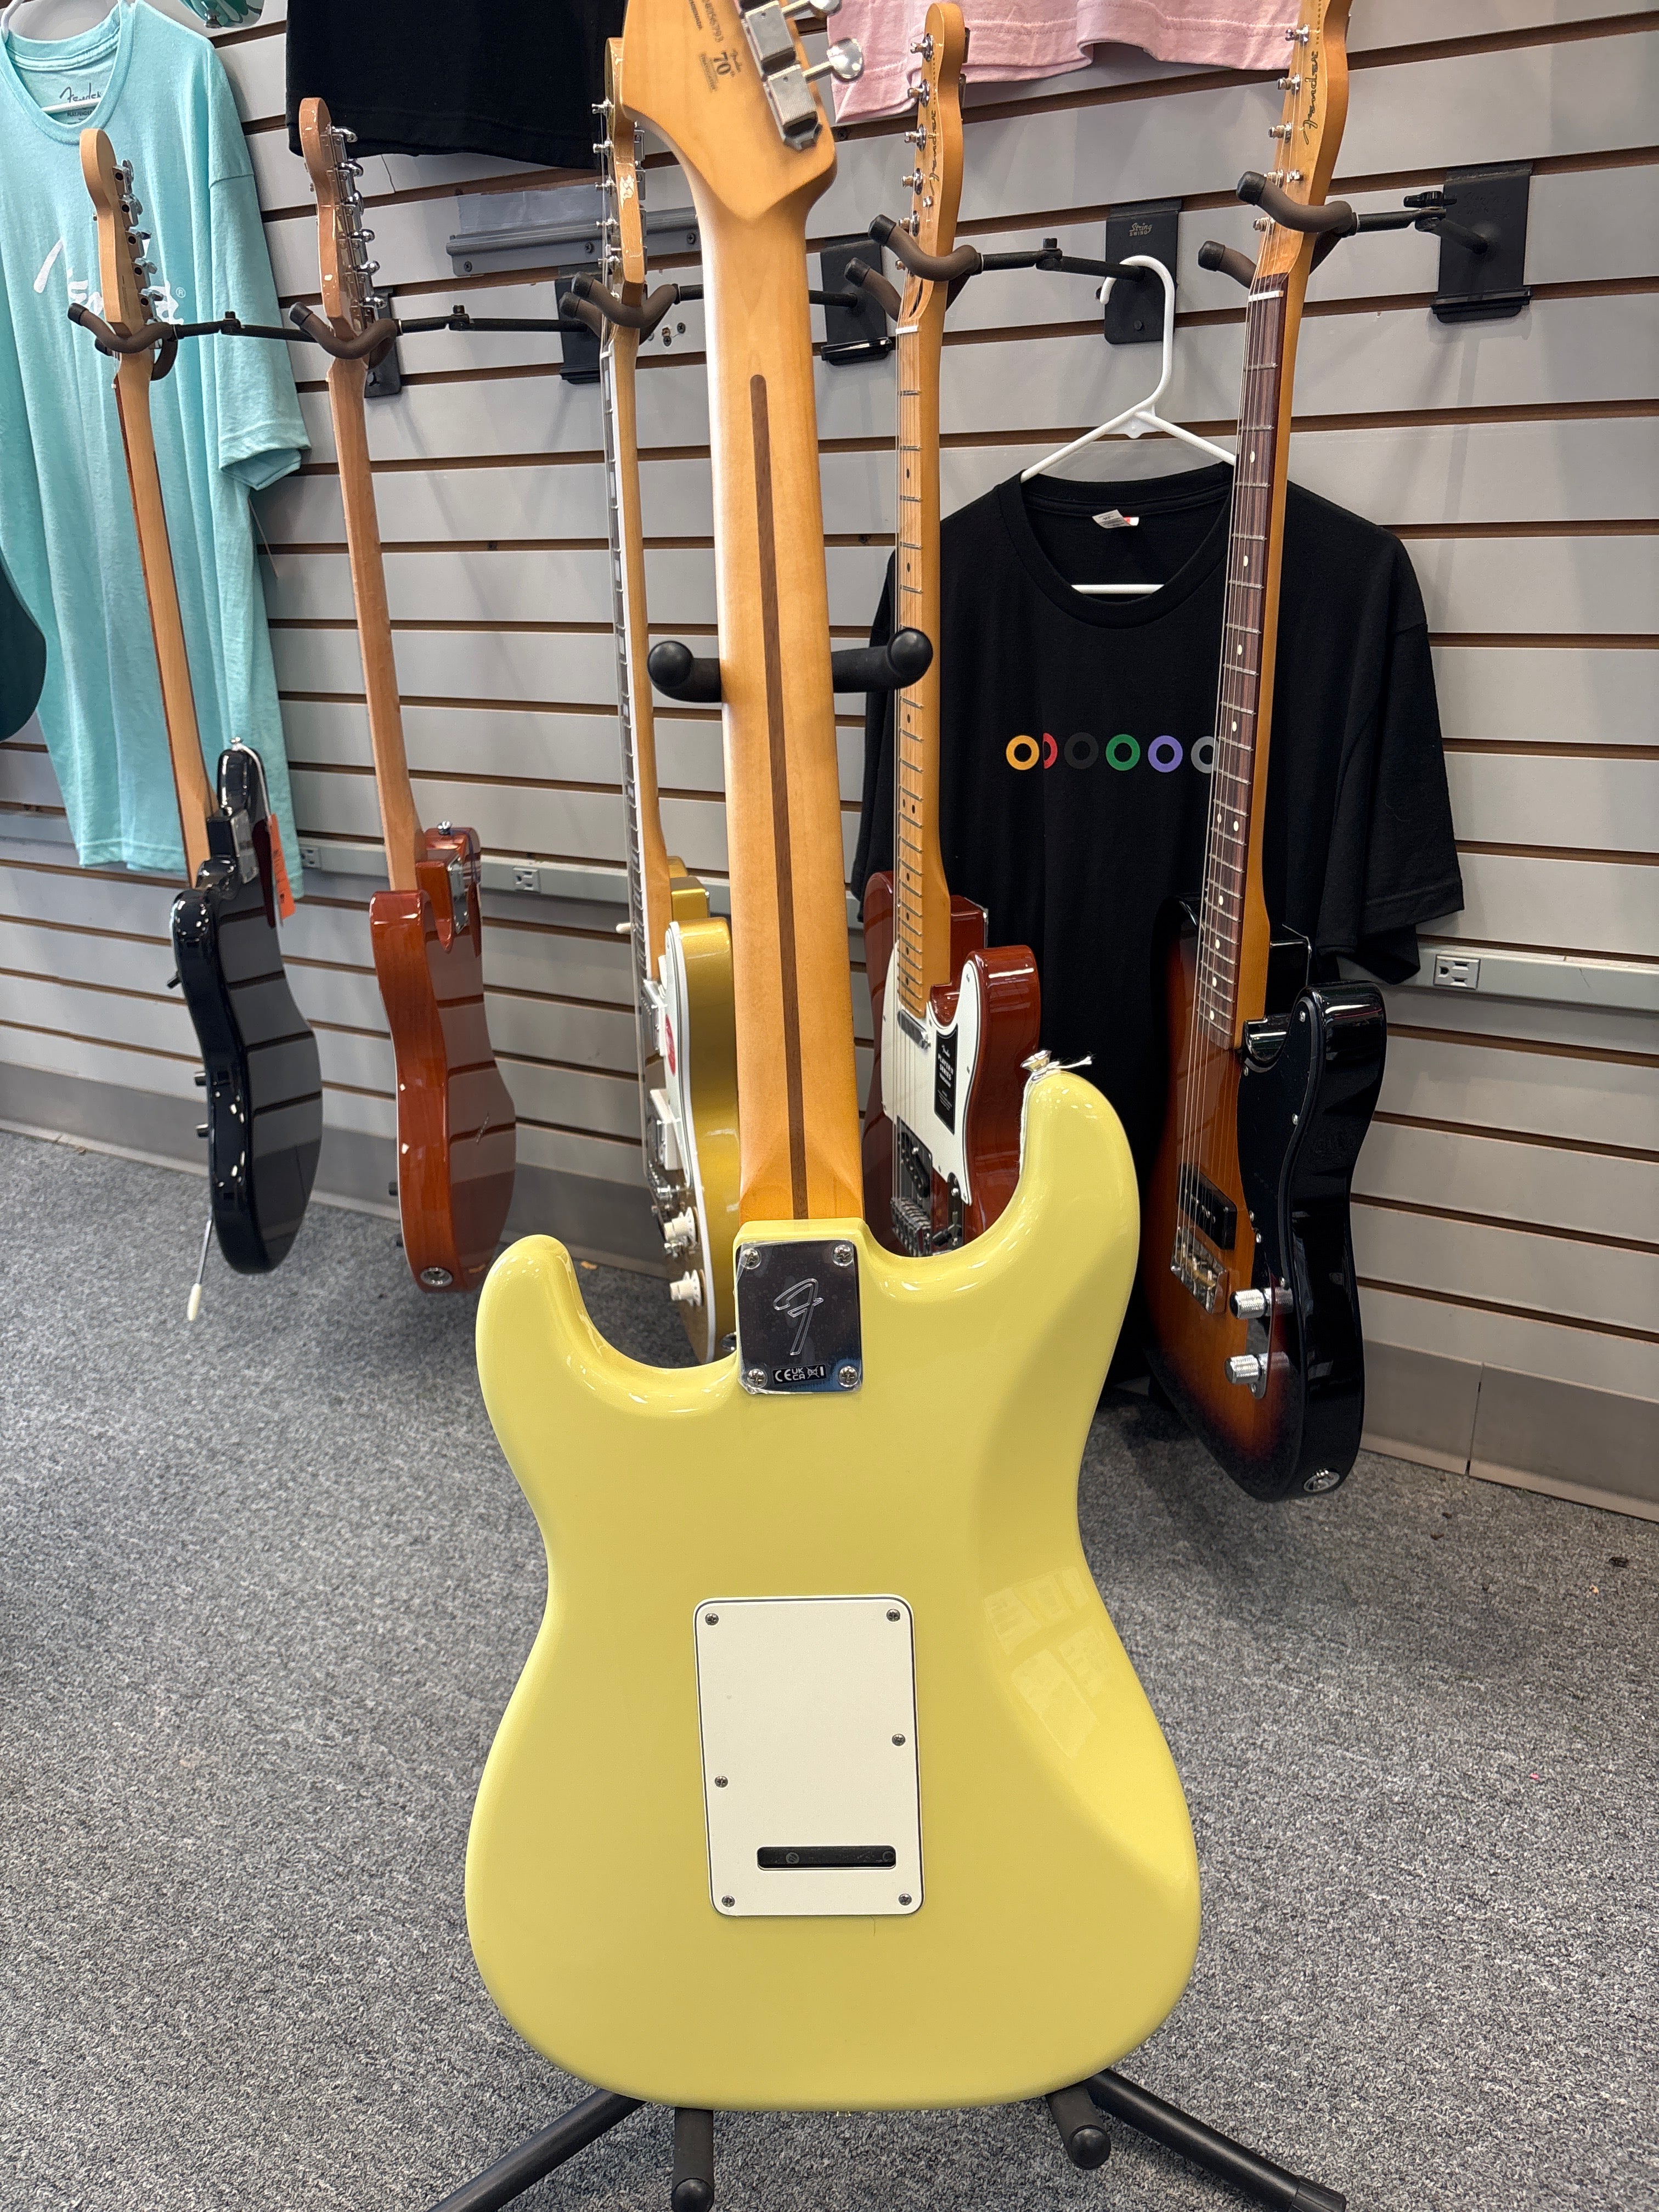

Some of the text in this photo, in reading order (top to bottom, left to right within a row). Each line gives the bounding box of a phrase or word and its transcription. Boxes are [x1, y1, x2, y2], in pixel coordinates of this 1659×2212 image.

[1302, 50, 1319, 145] Fender
[929, 110, 940, 196] Fender
[1129, 222, 1153, 233] String
[775, 1369, 792, 1382] CE
